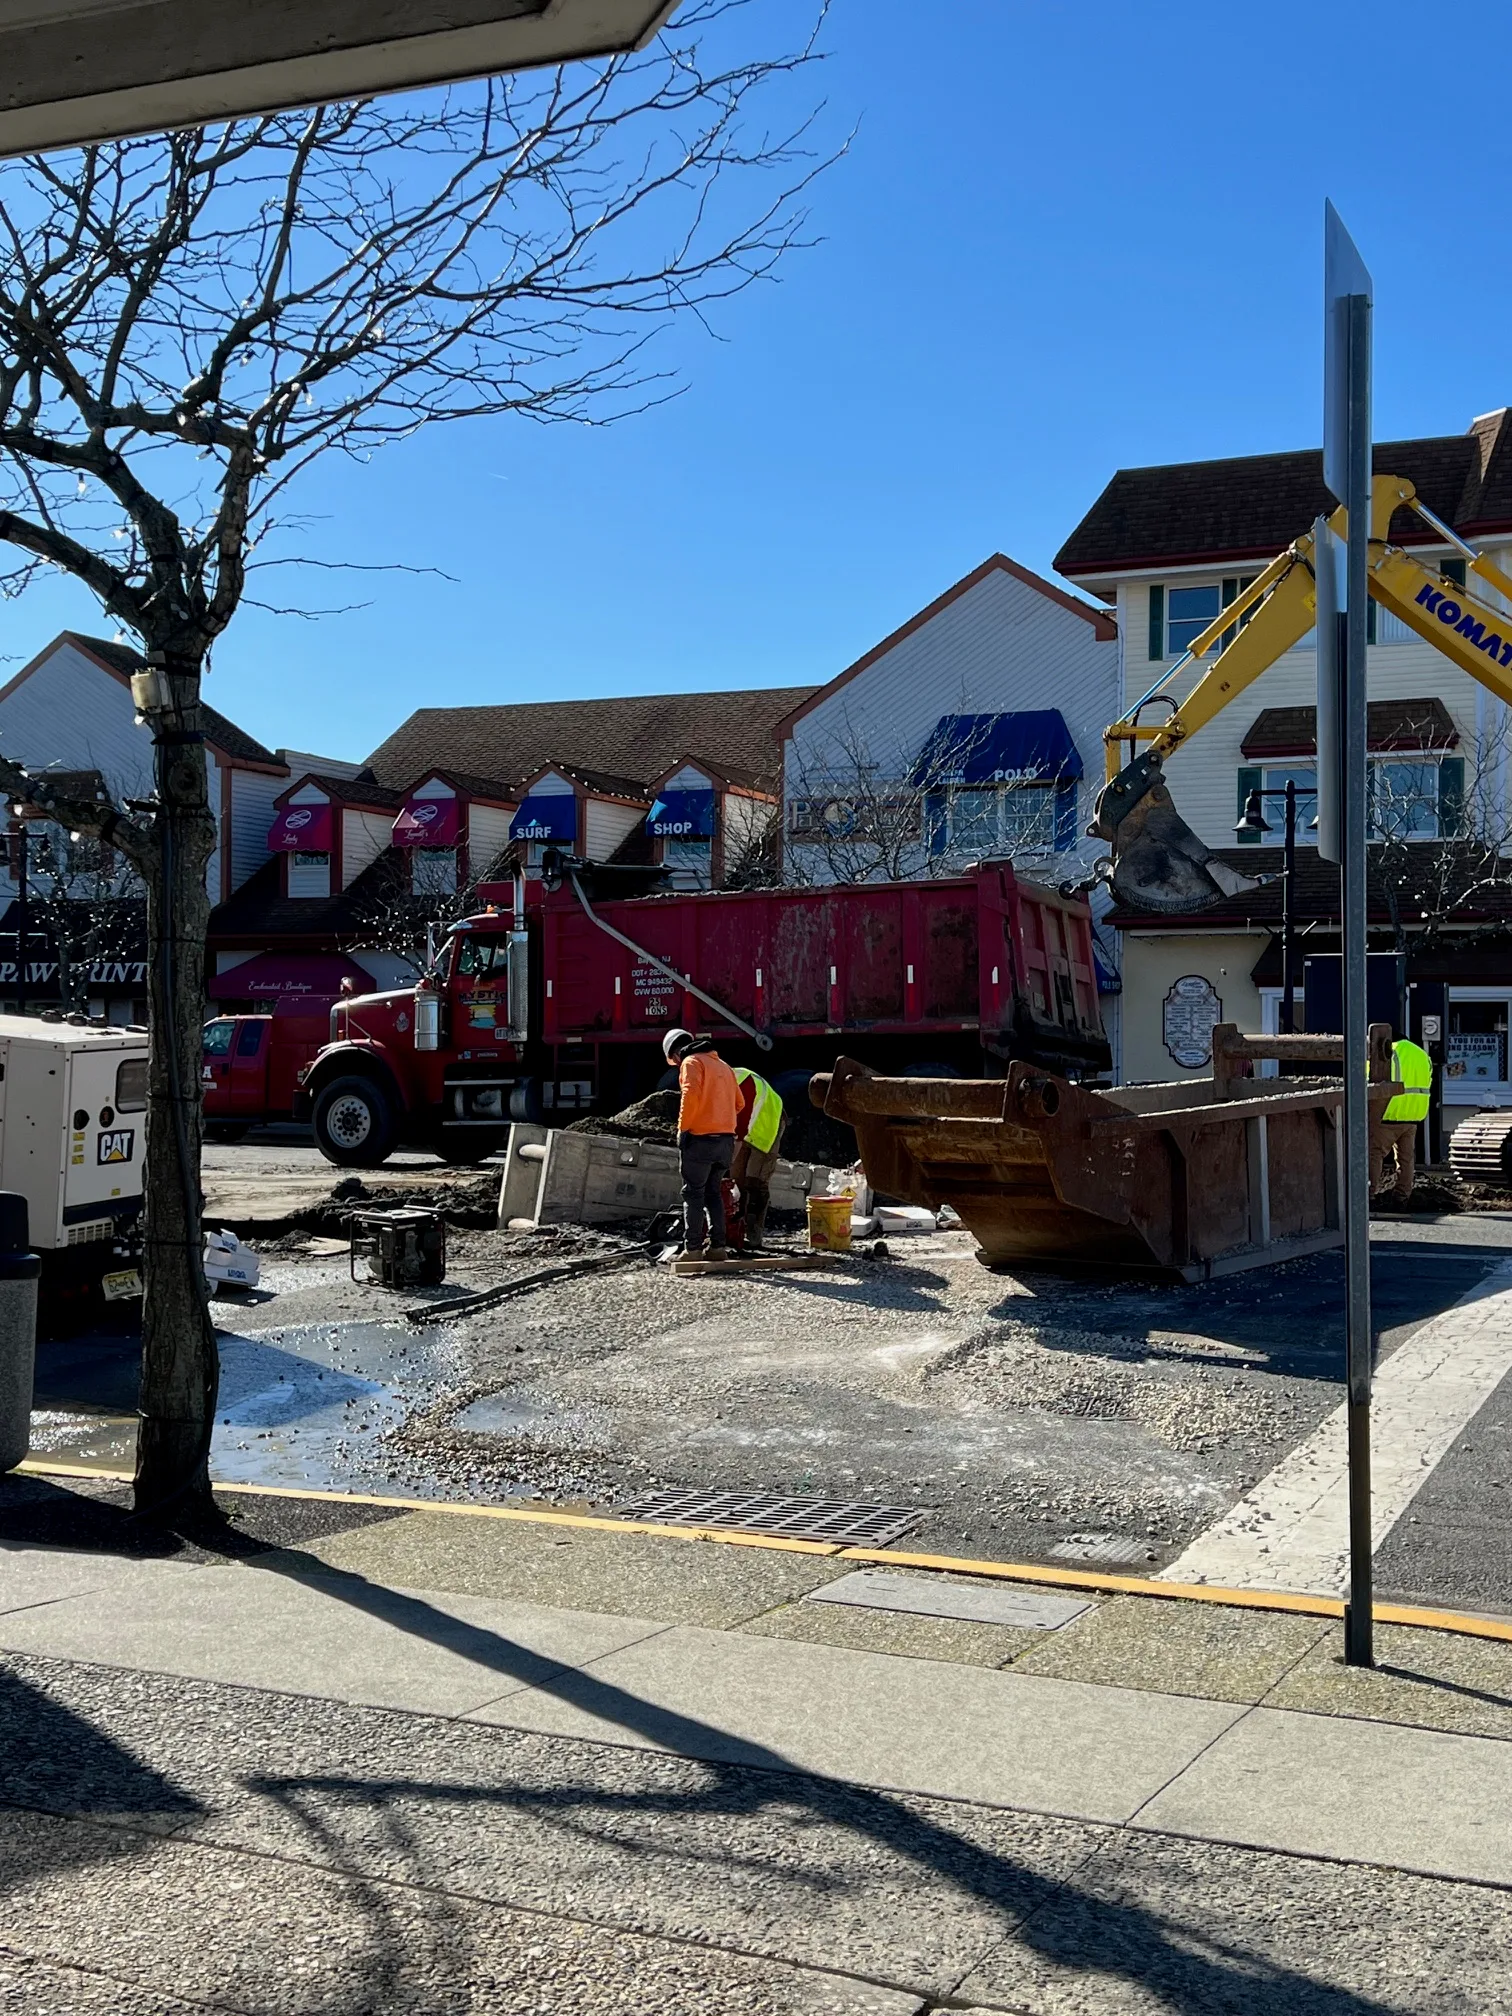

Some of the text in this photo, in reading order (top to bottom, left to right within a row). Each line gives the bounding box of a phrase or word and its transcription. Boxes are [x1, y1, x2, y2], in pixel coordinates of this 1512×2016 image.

[994, 768, 1037, 782] POLO
[516, 826, 552, 839] SURF
[653, 821, 693, 835] SHOP
[281, 980, 312, 994] Boutique
[634, 988, 651, 996] GVW
[645, 1006, 668, 1016] TONS
[100, 1132, 131, 1162] CAT
